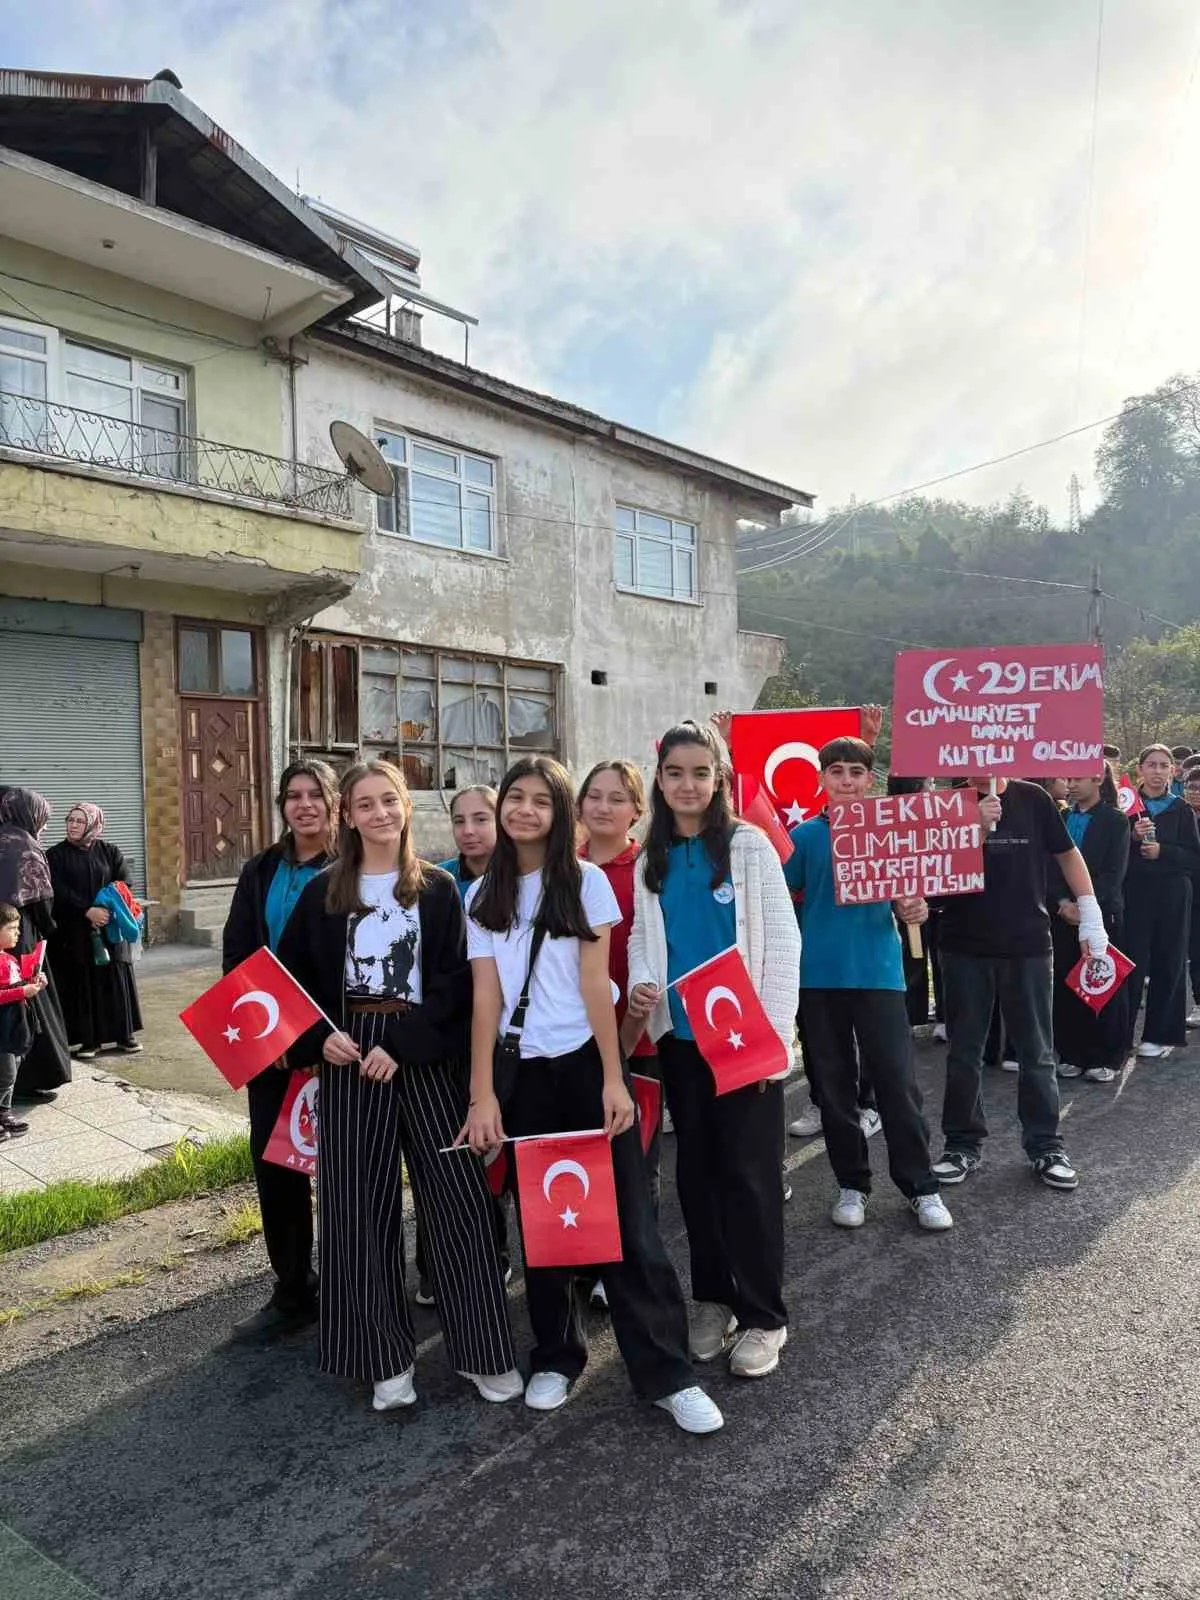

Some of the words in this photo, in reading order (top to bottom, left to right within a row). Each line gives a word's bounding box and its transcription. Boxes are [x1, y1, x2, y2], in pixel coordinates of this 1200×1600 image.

[977, 662, 1026, 694] 29
[1029, 662, 1103, 692] EKİM
[905, 703, 1041, 726] CUMHURİYET
[938, 743, 1015, 767] KUTLU
[832, 802, 865, 830] 29
[875, 791, 963, 826] EKİM
[833, 820, 981, 858] CUMHURİYET
[836, 854, 952, 882] BAYRAMI
[840, 877, 918, 903] KUTLU
[923, 872, 985, 895] OLSUN
